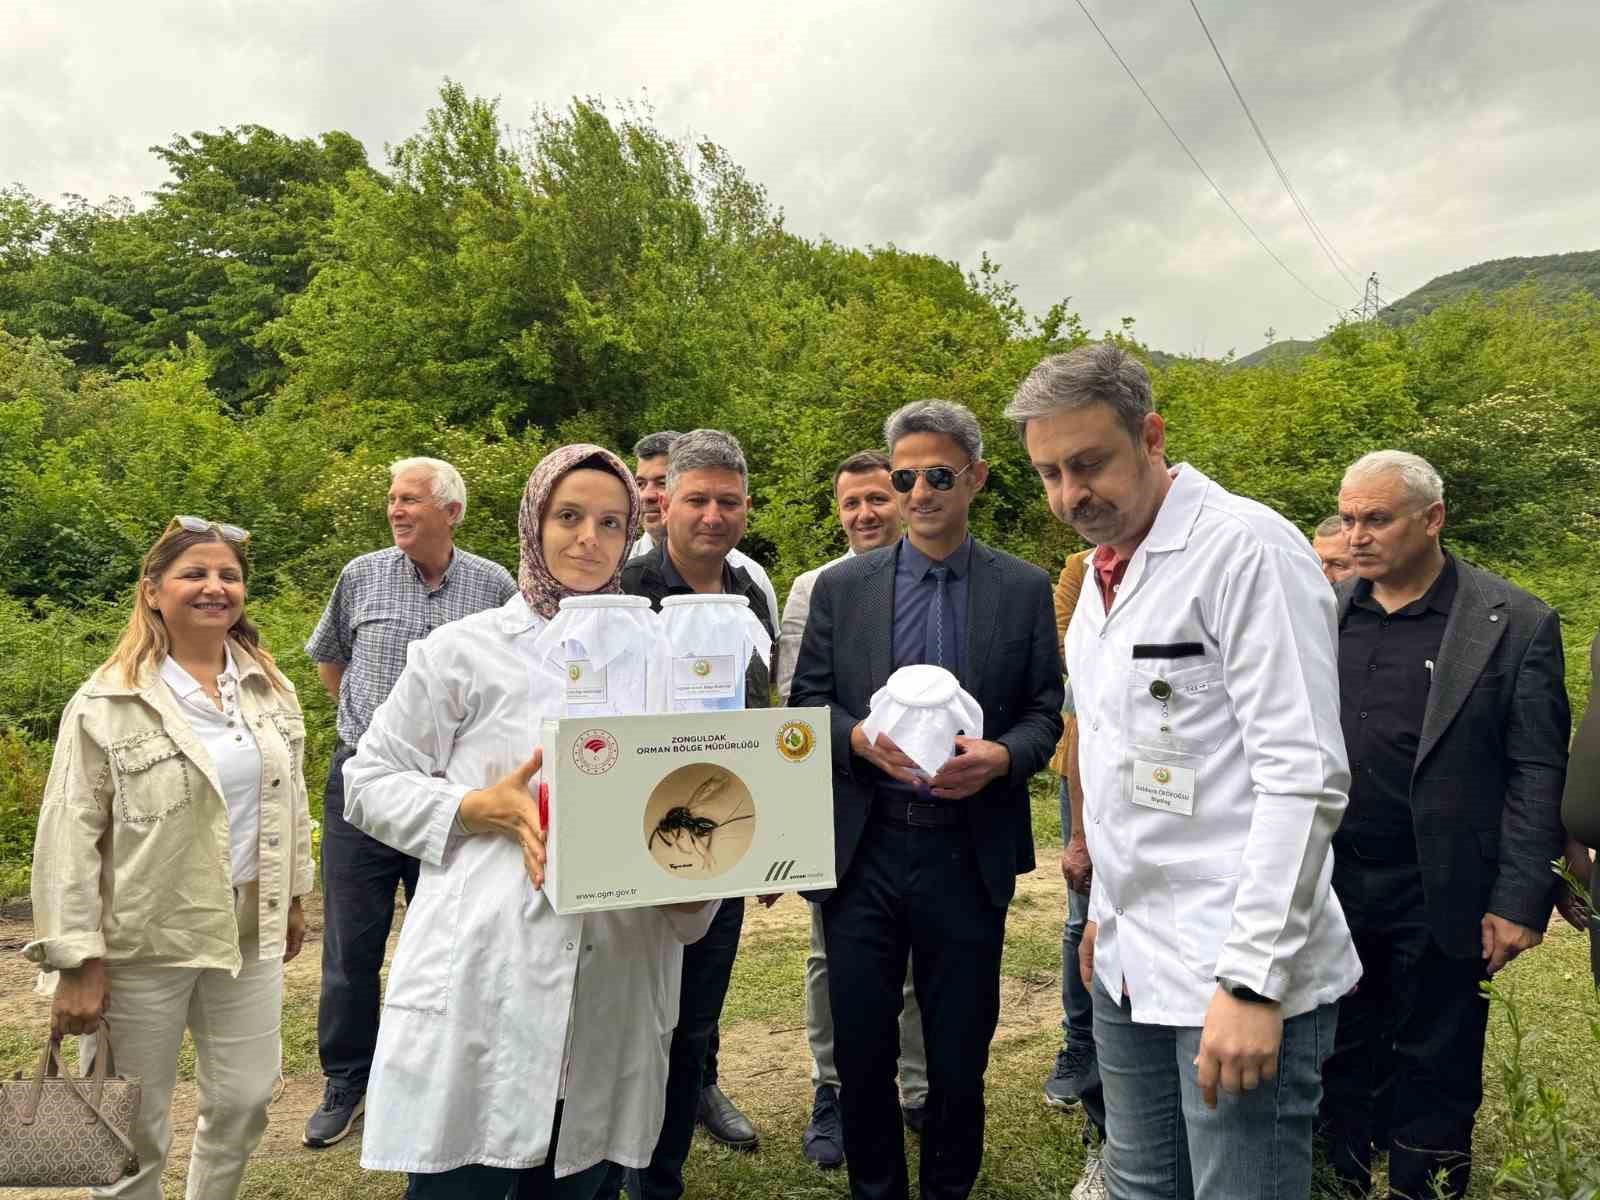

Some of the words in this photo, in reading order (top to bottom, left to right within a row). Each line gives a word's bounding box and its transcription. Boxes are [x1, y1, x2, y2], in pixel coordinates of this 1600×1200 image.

[672, 734, 727, 744] ZONGULDAK
[636, 746, 671, 755] ORMAN
[673, 744, 703, 753] BÖLGE
[705, 740, 760, 752] MÜDÜRLÜĞÜ
[576, 888, 638, 900] www.ogm.gov.tr
